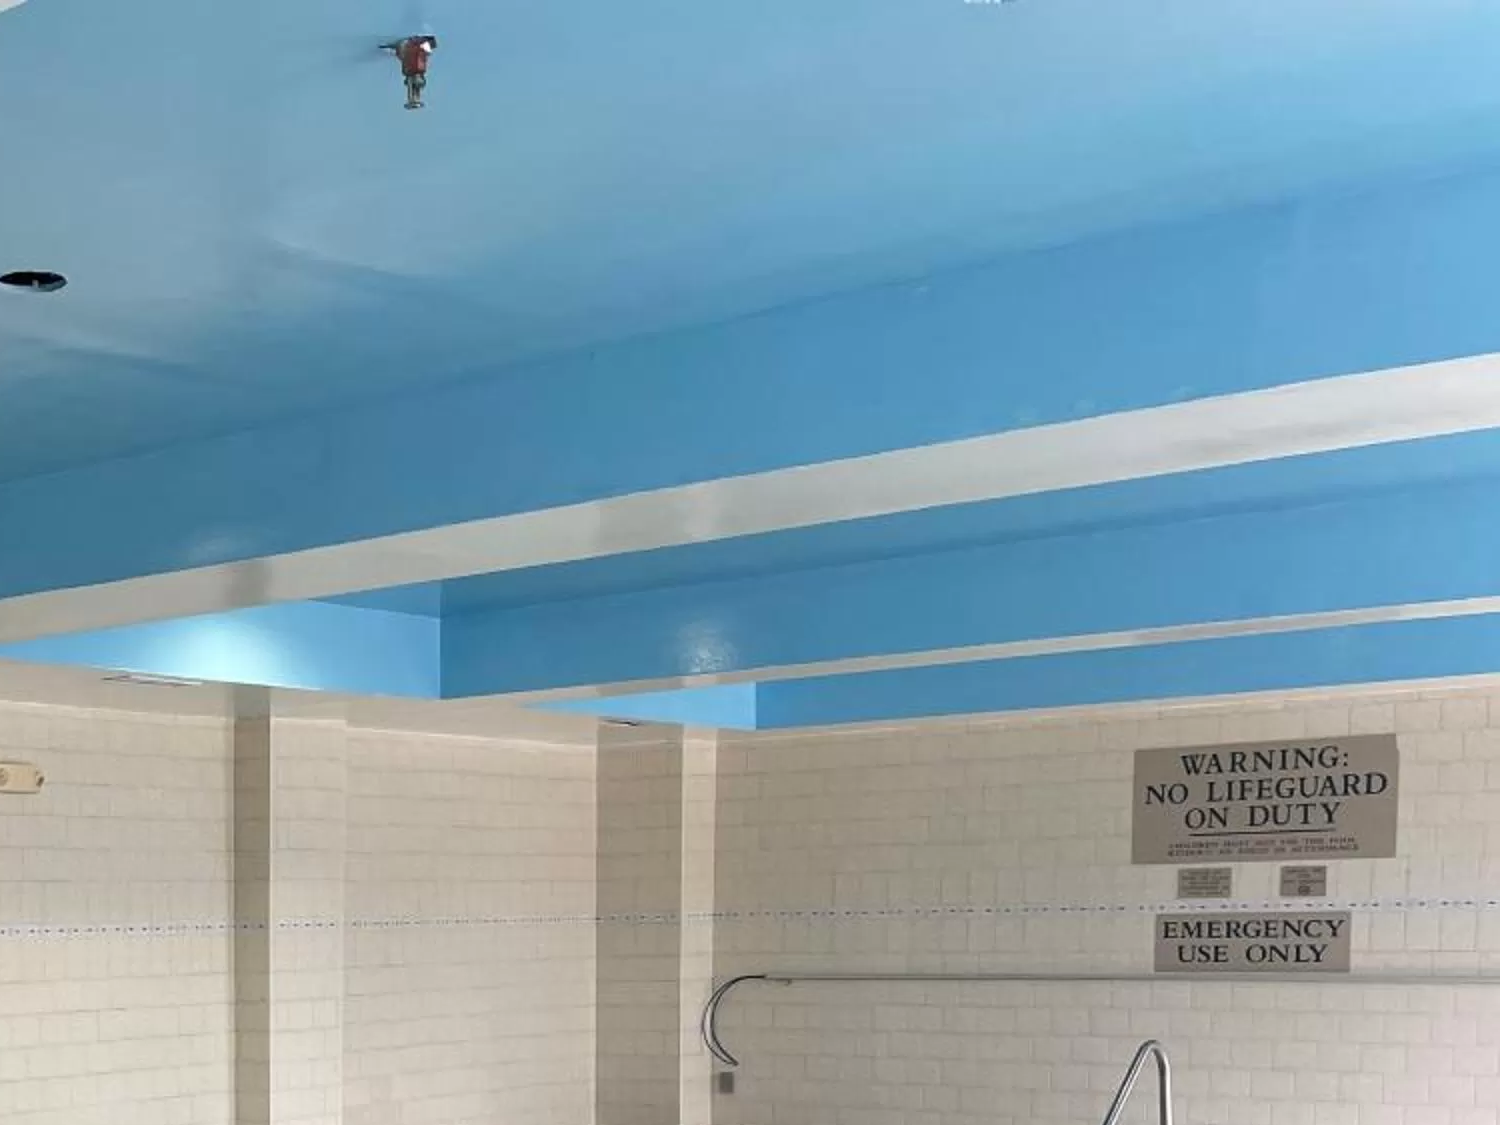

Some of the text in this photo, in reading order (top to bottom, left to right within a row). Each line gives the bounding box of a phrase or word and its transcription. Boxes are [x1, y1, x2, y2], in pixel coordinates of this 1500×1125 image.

[1180, 745, 1349, 776] WARNING:
[1145, 772, 1388, 805] NO LIFEGUARD
[1185, 802, 1341, 829] ON DUTY
[1163, 918, 1346, 940] EMERGENCY
[1177, 943, 1329, 963] USE ONLY
